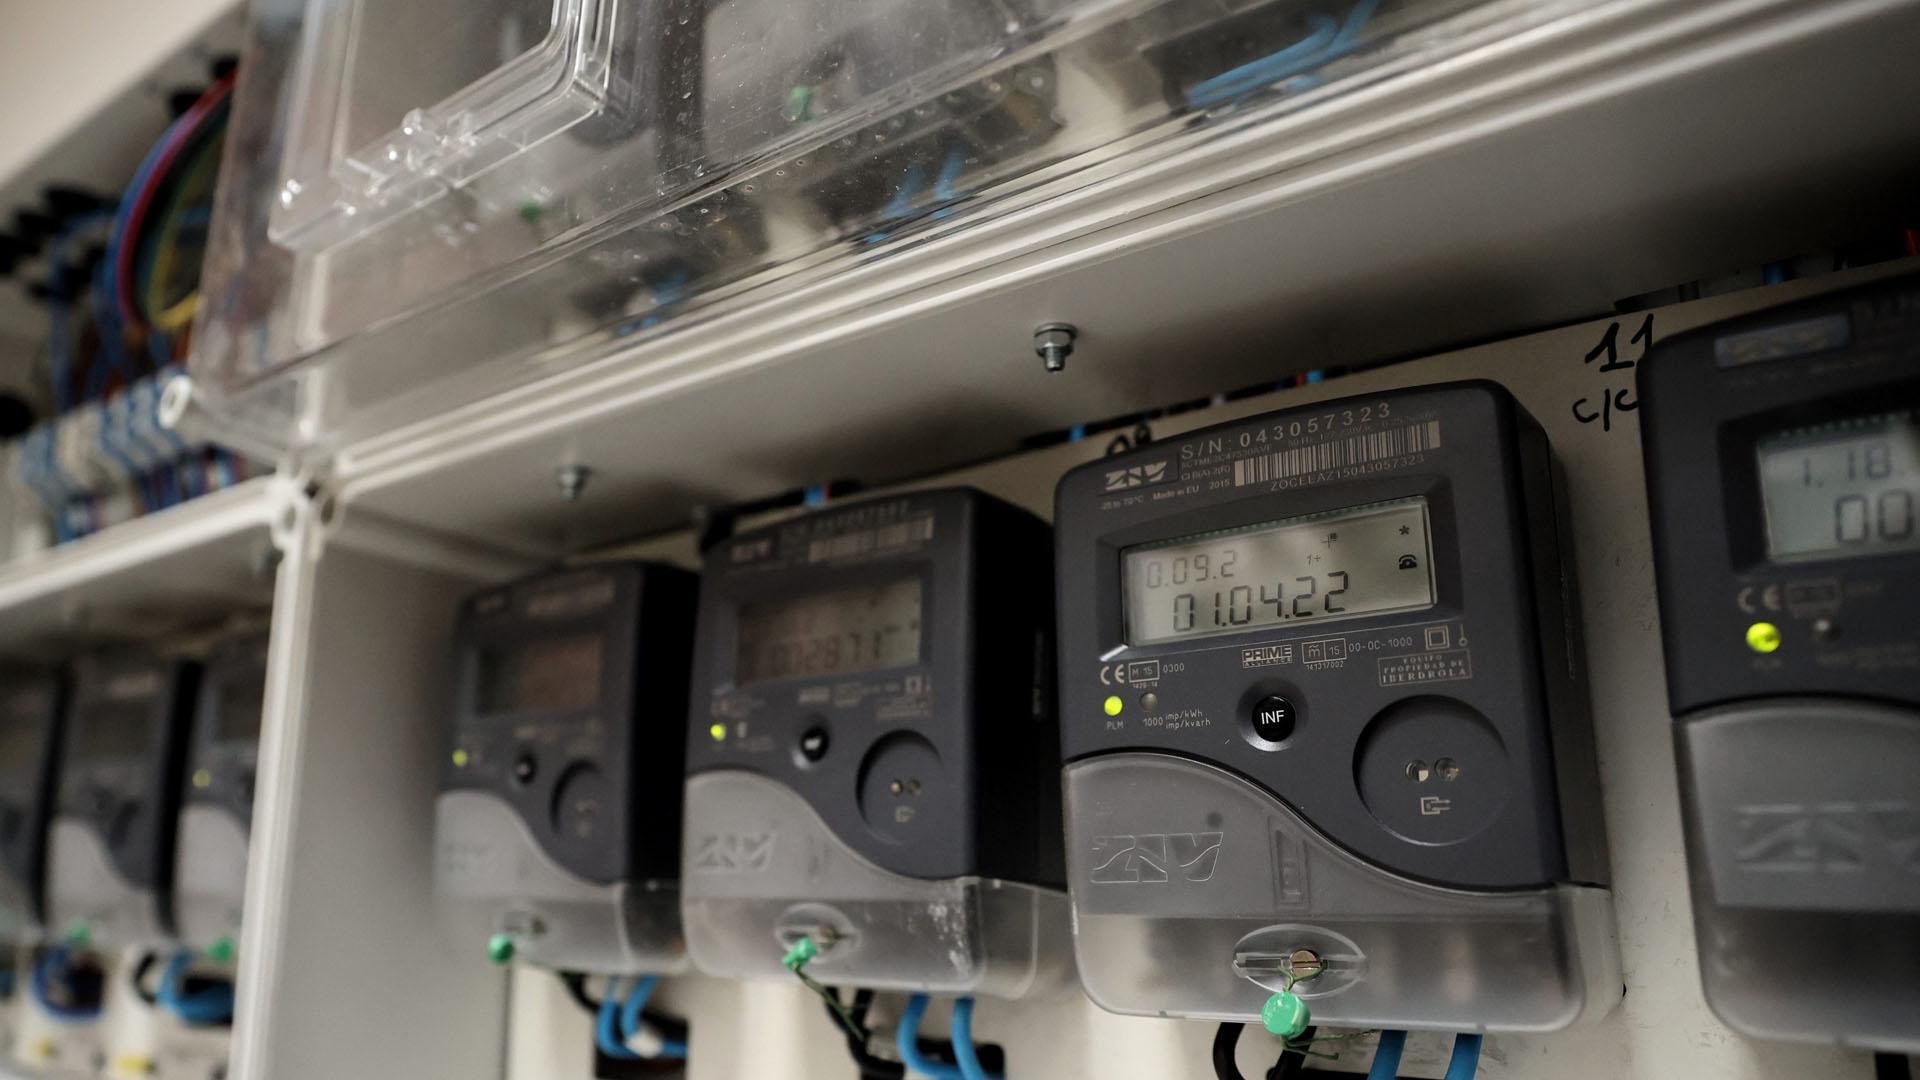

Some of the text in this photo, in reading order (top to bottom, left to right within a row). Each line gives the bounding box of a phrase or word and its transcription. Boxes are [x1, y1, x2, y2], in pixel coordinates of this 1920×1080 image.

[1239, 402, 1391, 448] 043057323
[1146, 550, 1236, 589] 0.09.2
[1173, 569, 1349, 632] 01.04.22
[1243, 645, 1292, 661] PRIME
[1328, 645, 1341, 656] 15
[1100, 664, 1125, 685] CE
[1382, 667, 1467, 684] IBERDROLA
[1106, 721, 1125, 730] PLM
[1143, 708, 1203, 727] 1000 imp/kWh
[1261, 709, 1285, 725] INF
